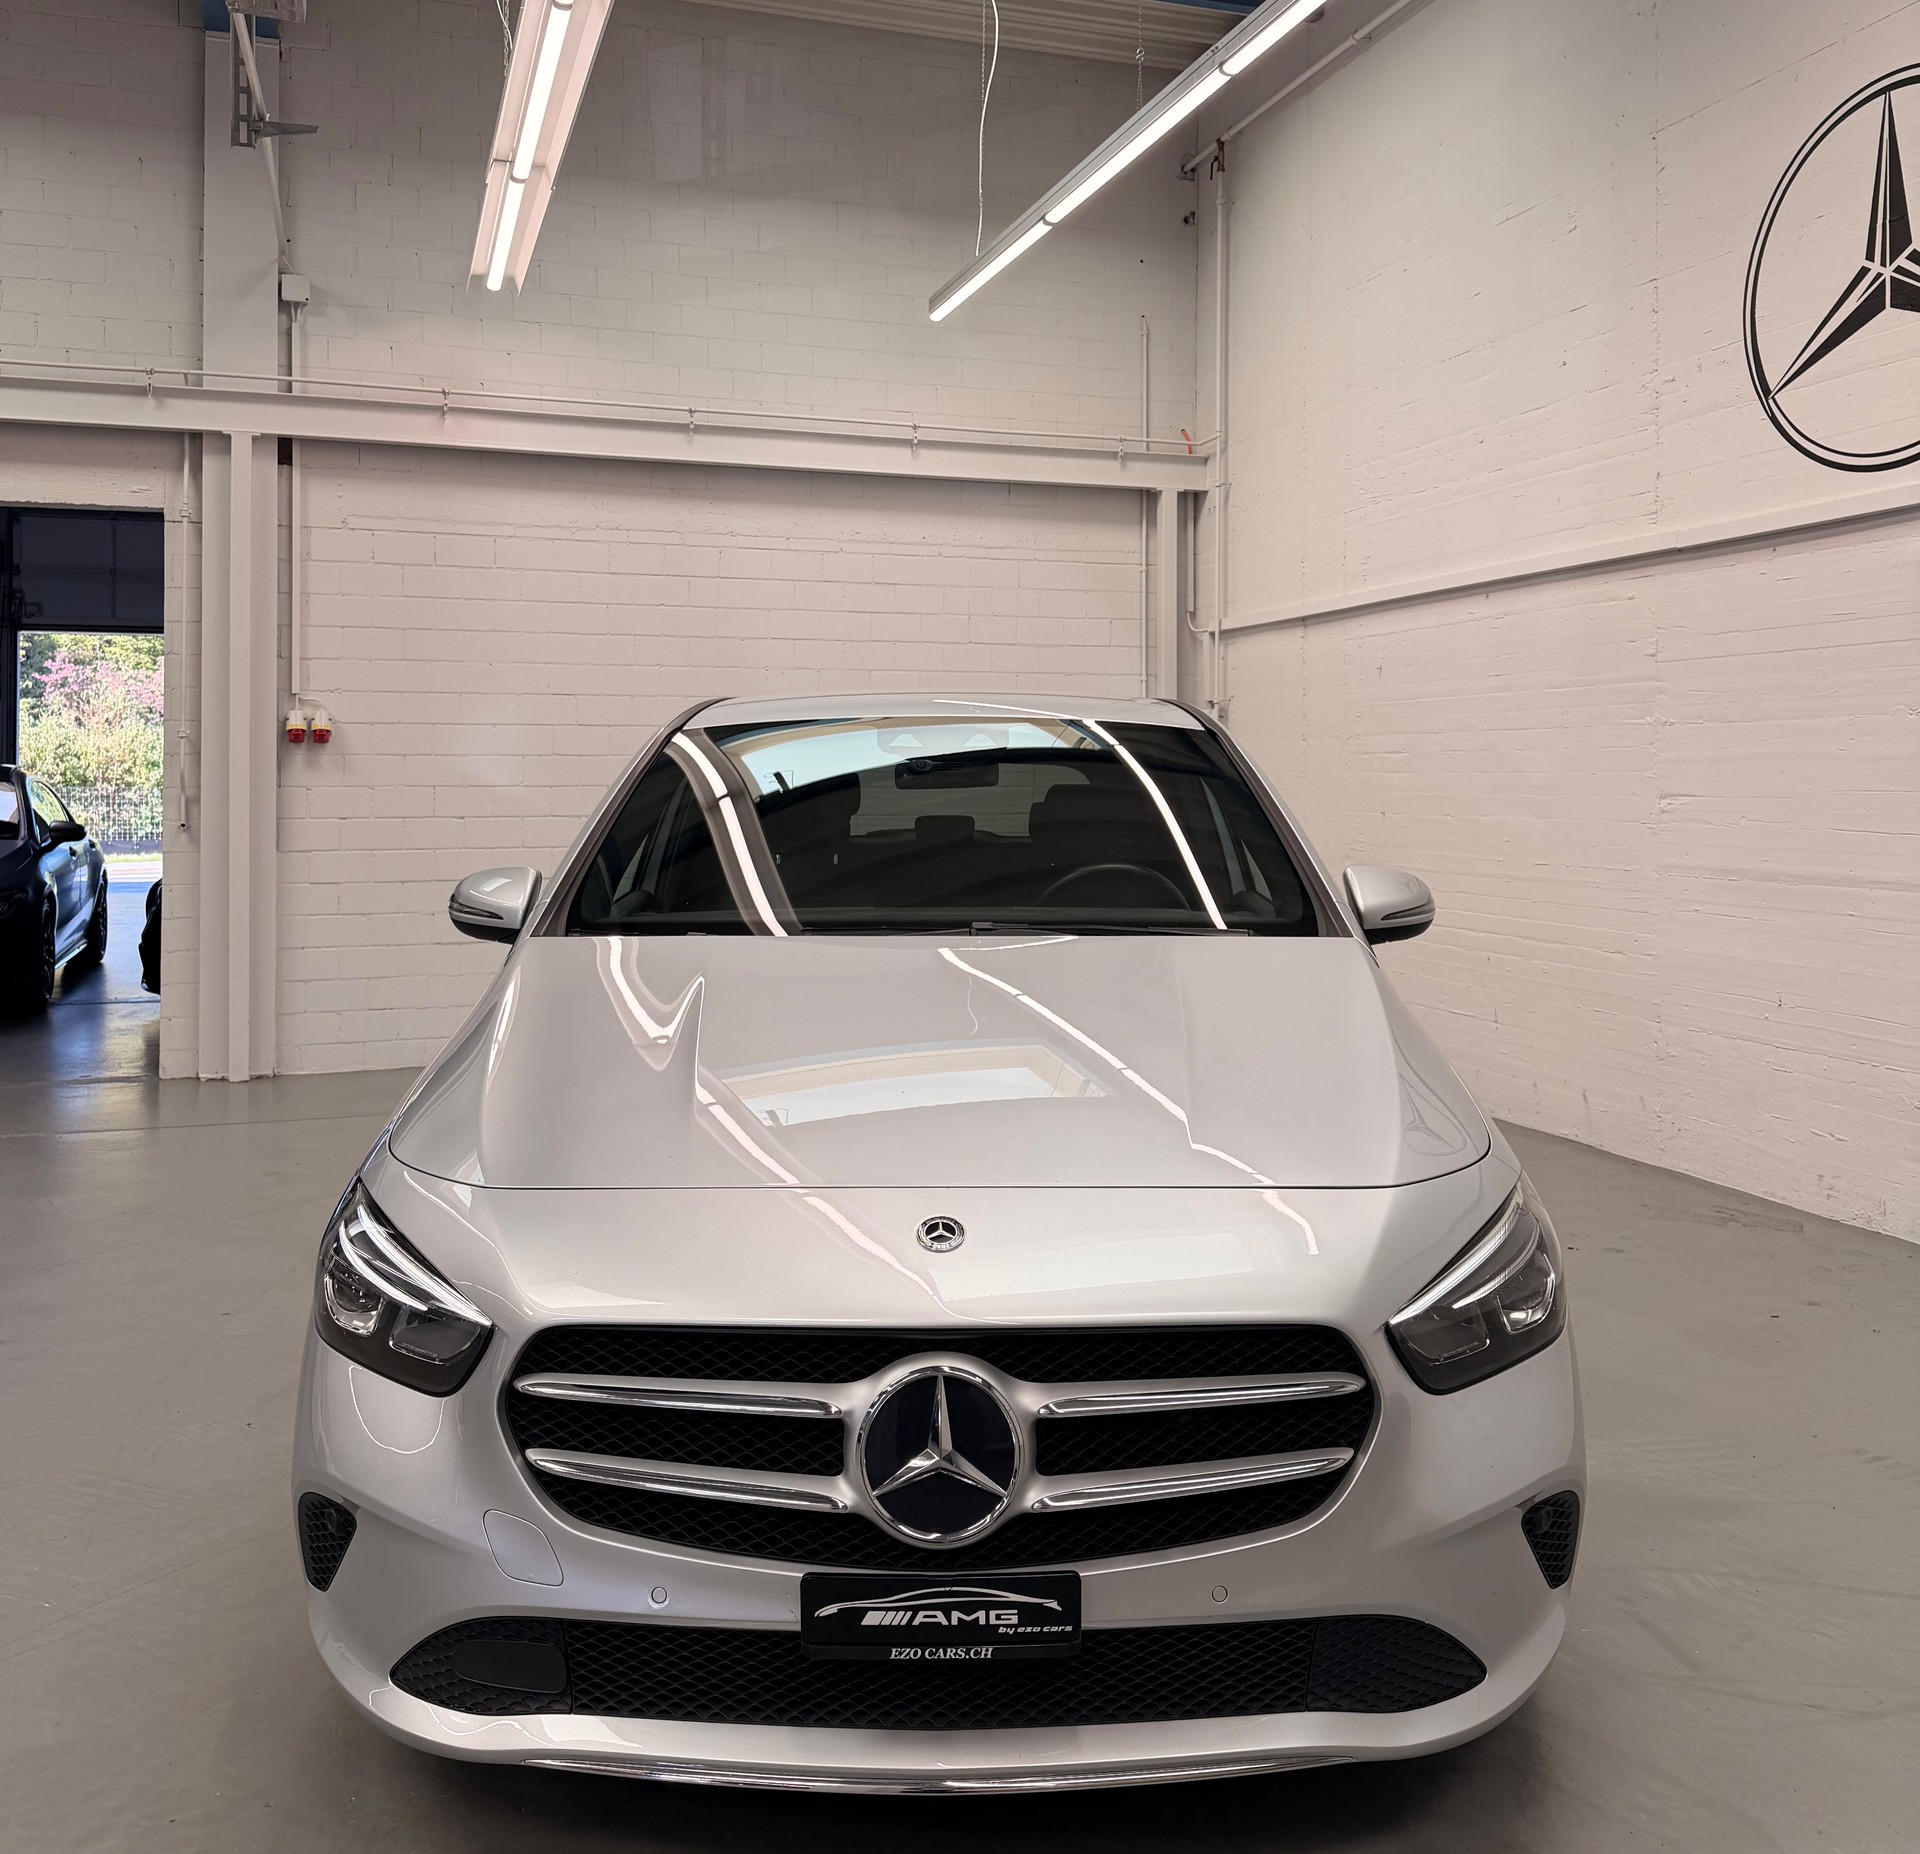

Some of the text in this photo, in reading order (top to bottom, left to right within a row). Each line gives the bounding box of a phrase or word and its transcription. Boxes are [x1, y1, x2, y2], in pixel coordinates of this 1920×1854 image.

[997, 1626, 1015, 1636] by
[1042, 1625, 1073, 1633] cars
[889, 1647, 993, 1659] EZO CARS.CH
